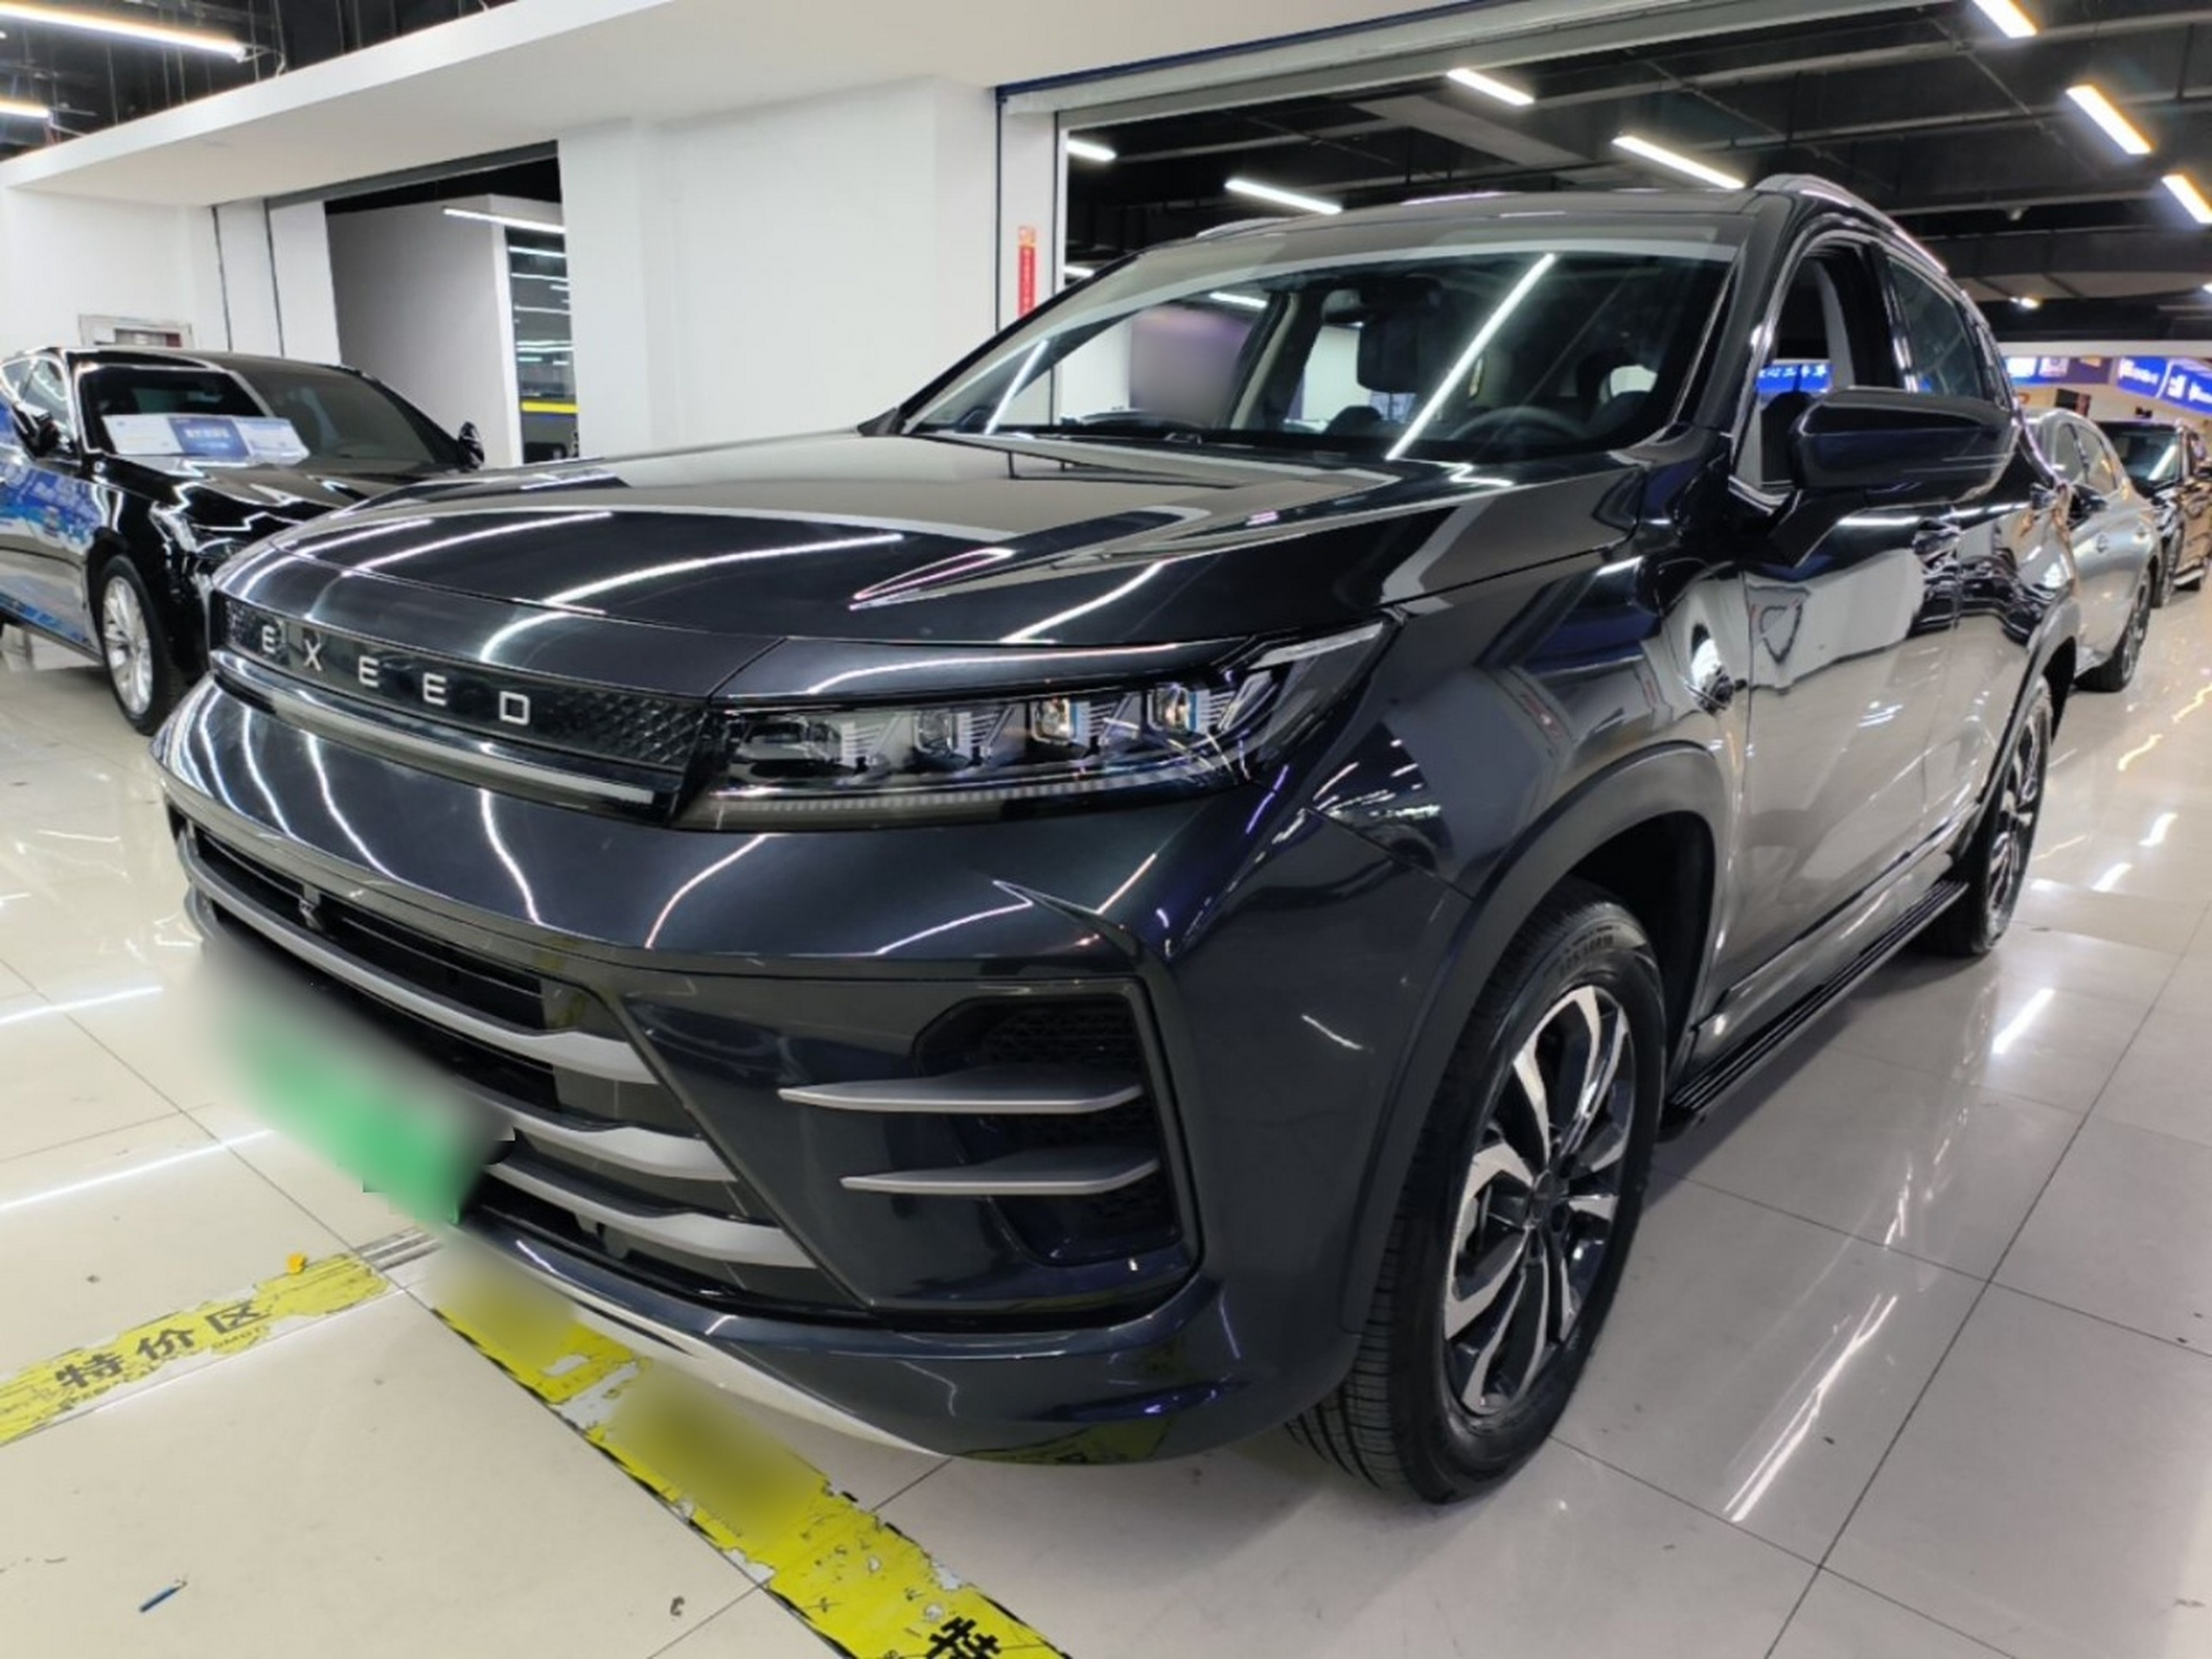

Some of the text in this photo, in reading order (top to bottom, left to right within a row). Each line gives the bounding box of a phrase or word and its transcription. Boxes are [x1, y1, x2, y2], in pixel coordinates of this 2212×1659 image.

[262, 624, 529, 726] EXEED
[55, 1300, 271, 1388] 特价区
